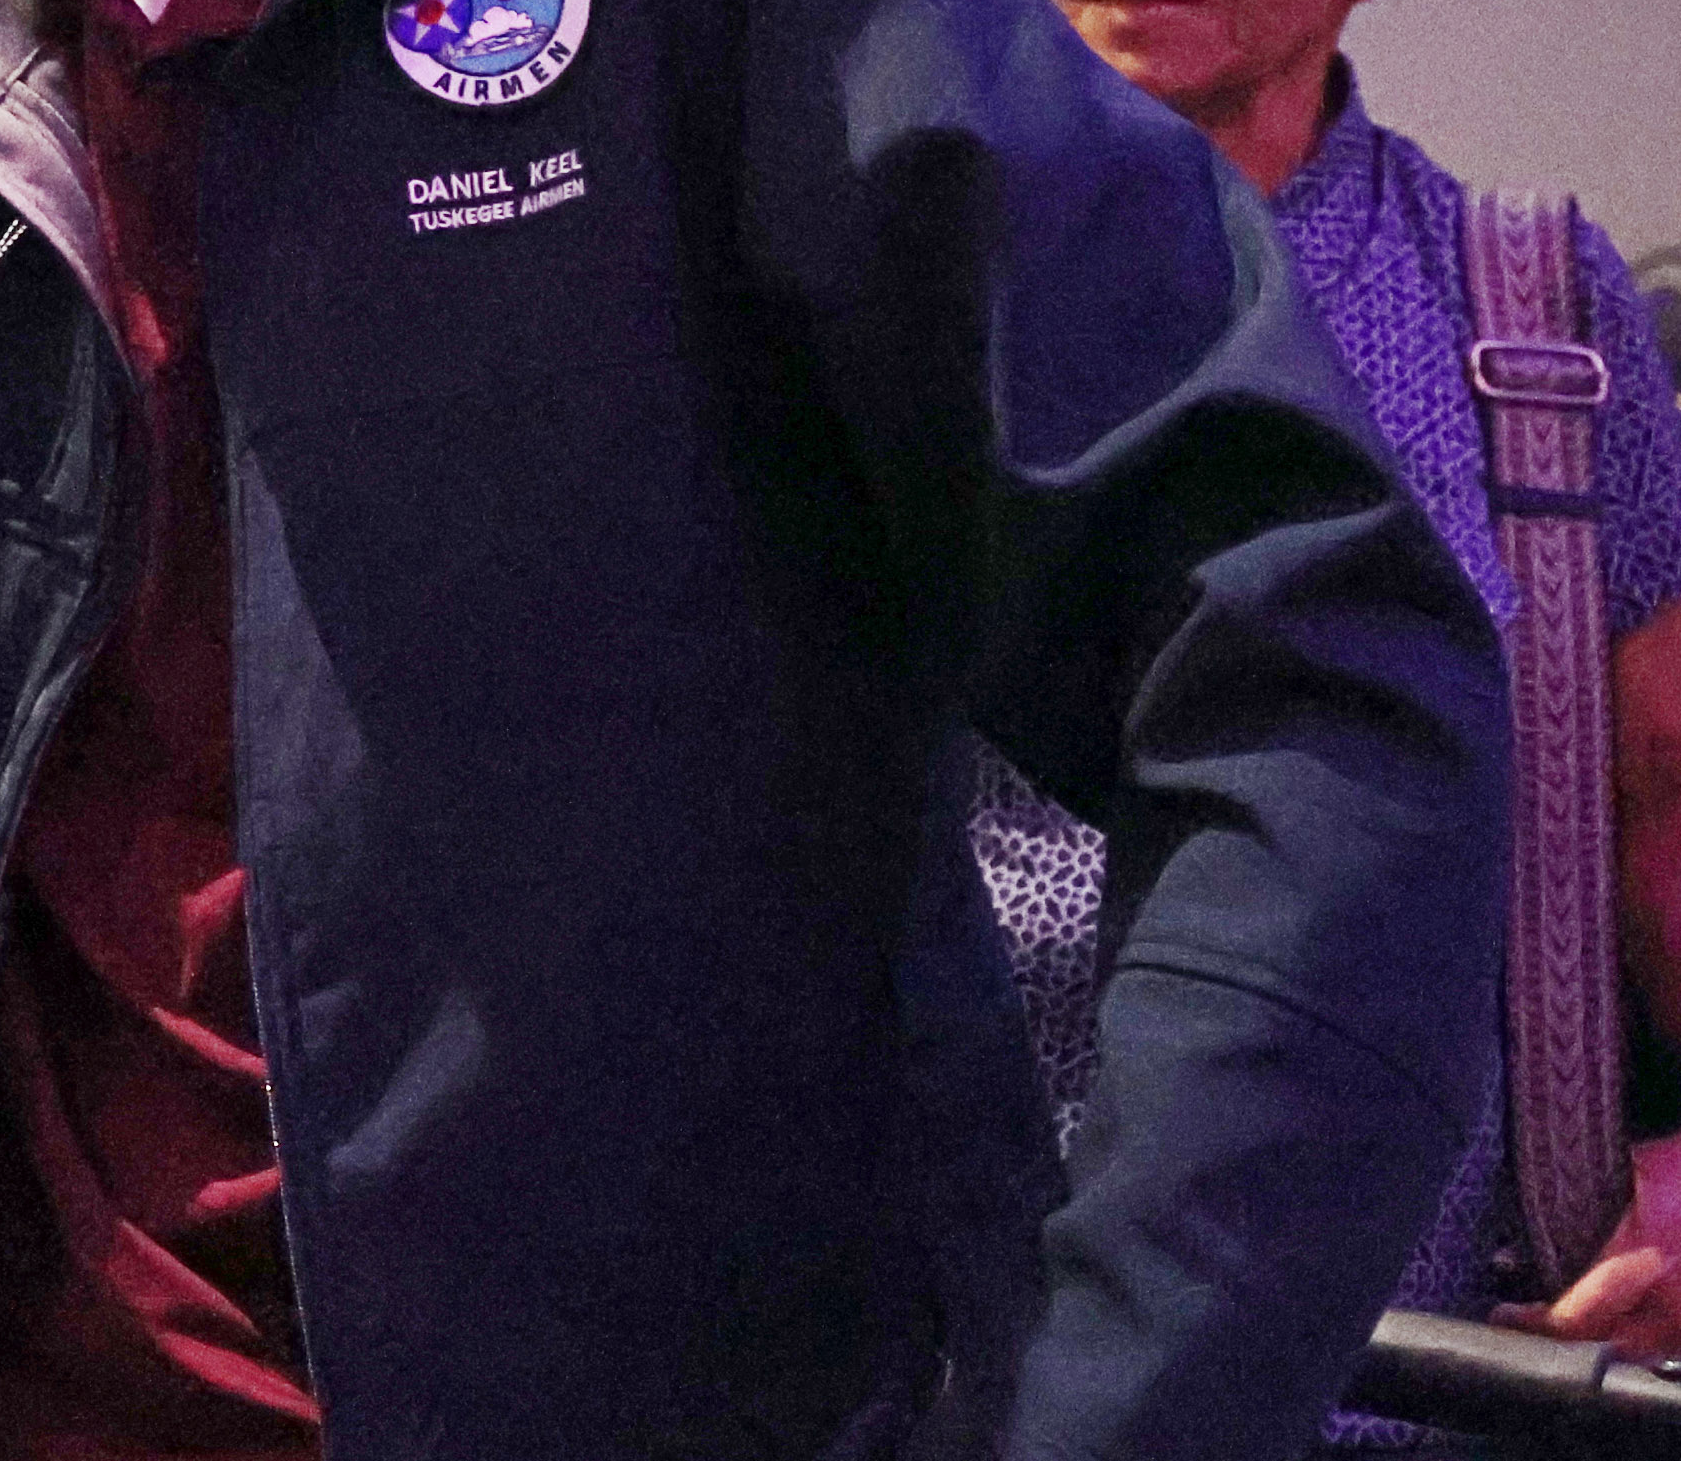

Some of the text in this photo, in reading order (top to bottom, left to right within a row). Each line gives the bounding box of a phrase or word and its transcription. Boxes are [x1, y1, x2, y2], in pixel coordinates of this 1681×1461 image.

[433, 40, 572, 101] AIRMEN
[407, 148, 583, 205] DANIEL KEEL
[408, 178, 585, 233] TUSKEGEE AIRMEN
